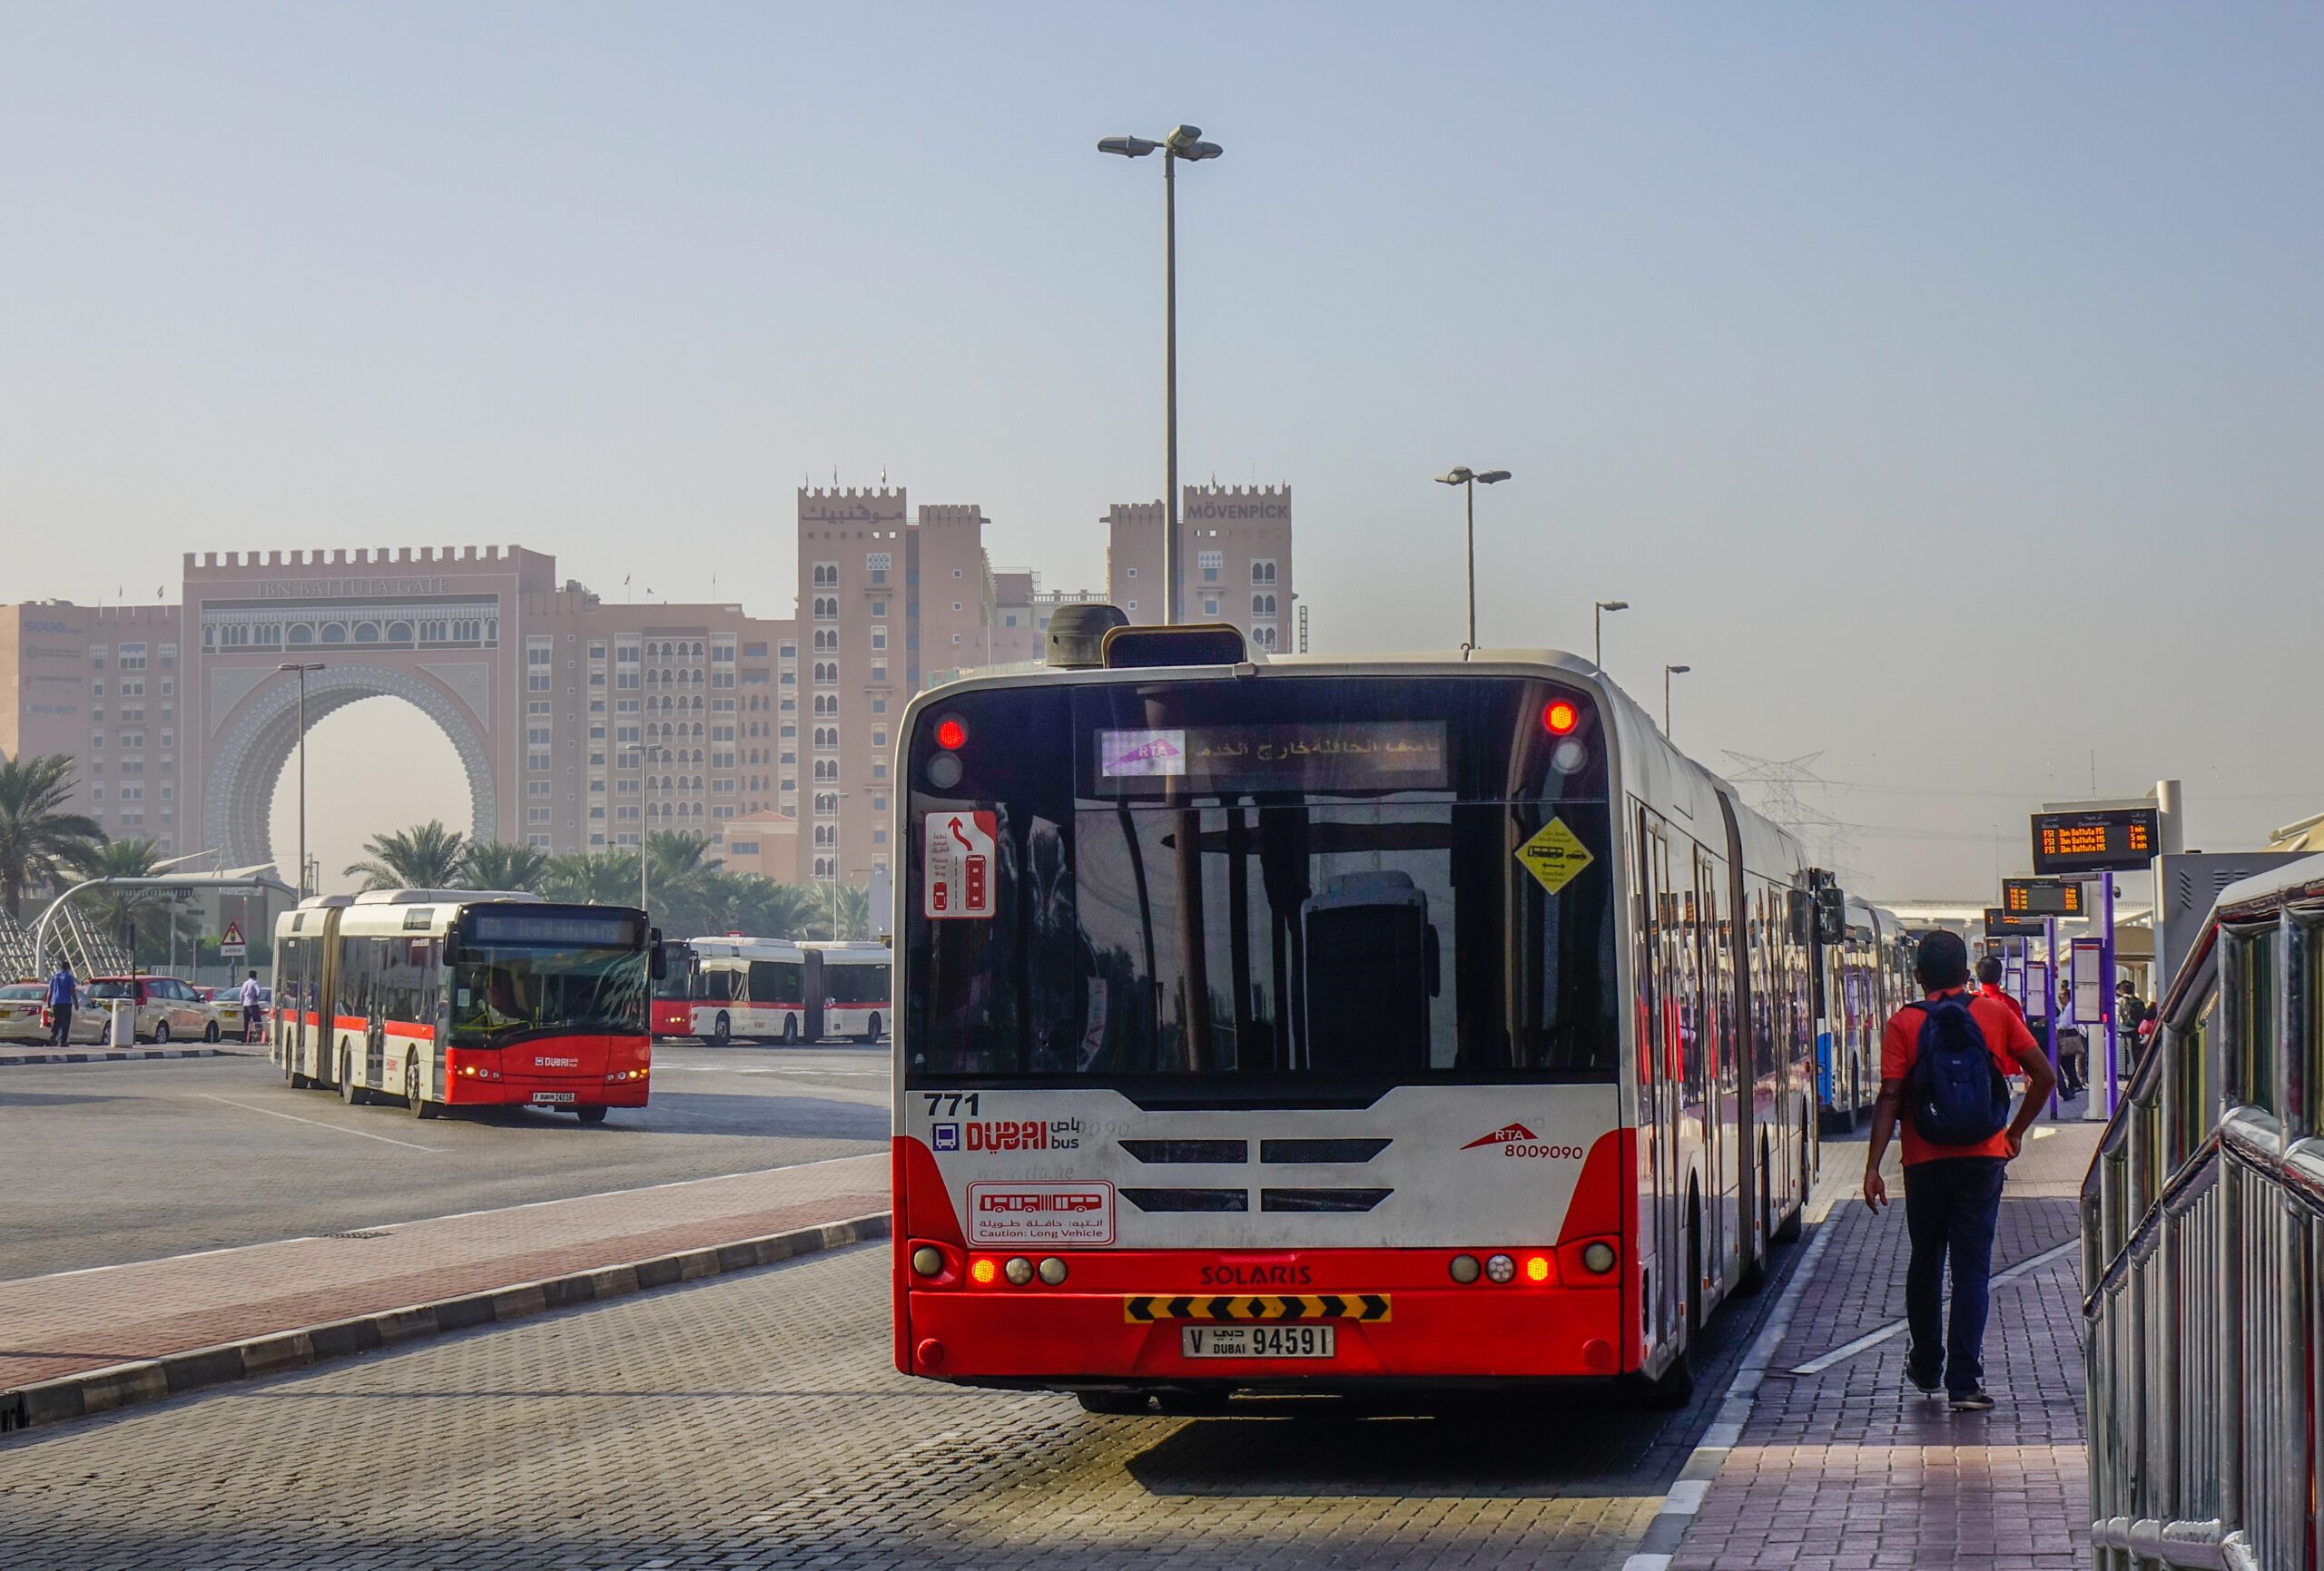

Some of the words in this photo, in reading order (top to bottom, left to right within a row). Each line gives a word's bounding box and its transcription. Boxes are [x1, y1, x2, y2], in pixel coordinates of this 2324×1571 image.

[258, 580, 290, 597] IBN
[300, 578, 388, 596] BATTUTA
[397, 577, 449, 594] GATE
[1137, 745, 1168, 757] RTA
[2060, 829, 2071, 837] Ibn
[2072, 827, 2094, 836] Battuta
[2060, 837, 2071, 845] Ibn
[2072, 836, 2095, 844] Battuta
[2061, 845, 2072, 853] Ibn
[2073, 844, 2096, 852] Battuta
[545, 1057, 569, 1067] DUBAI
[924, 1093, 979, 1116] 771
[1050, 1117, 1079, 1134] باص
[966, 1121, 1047, 1154] DUBAI
[1495, 1130, 1525, 1141] RTA
[1051, 1135, 1079, 1149] bus
[1504, 1144, 1582, 1160] 8009090
[980, 1229, 1027, 1237] Caution:
[1030, 1229, 1059, 1239] Long
[1061, 1229, 1103, 1237] Vehicle
[1200, 1266, 1313, 1285] SOLARIS
[1190, 1330, 1203, 1353] V
[1253, 1328, 1326, 1355] 94591
[1213, 1330, 1245, 1341] دبي
[1213, 1343, 1246, 1354] DUBAI
